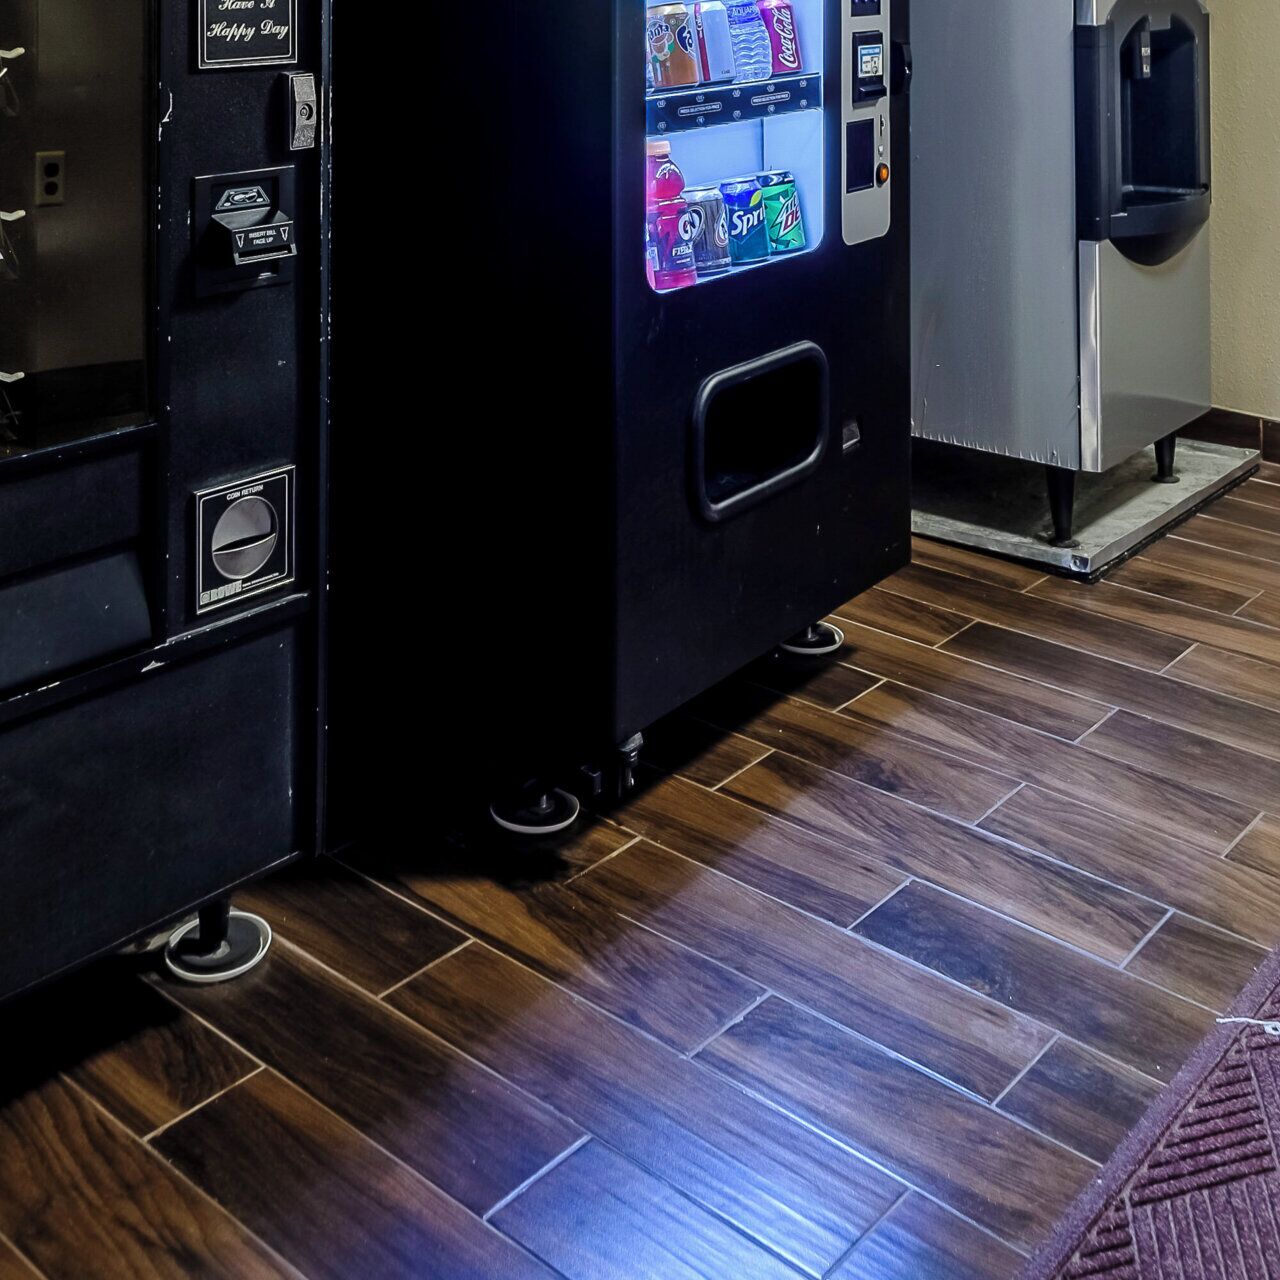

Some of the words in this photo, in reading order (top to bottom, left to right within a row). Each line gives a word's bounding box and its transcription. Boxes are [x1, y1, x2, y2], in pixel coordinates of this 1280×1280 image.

[207, 21, 256, 42] Happy
[260, 19, 290, 40] Day
[647, 23, 670, 40] anta
[730, 207, 766, 237] Spri
[226, 491, 241, 501] COIN
[241, 484, 264, 497] RETURN
